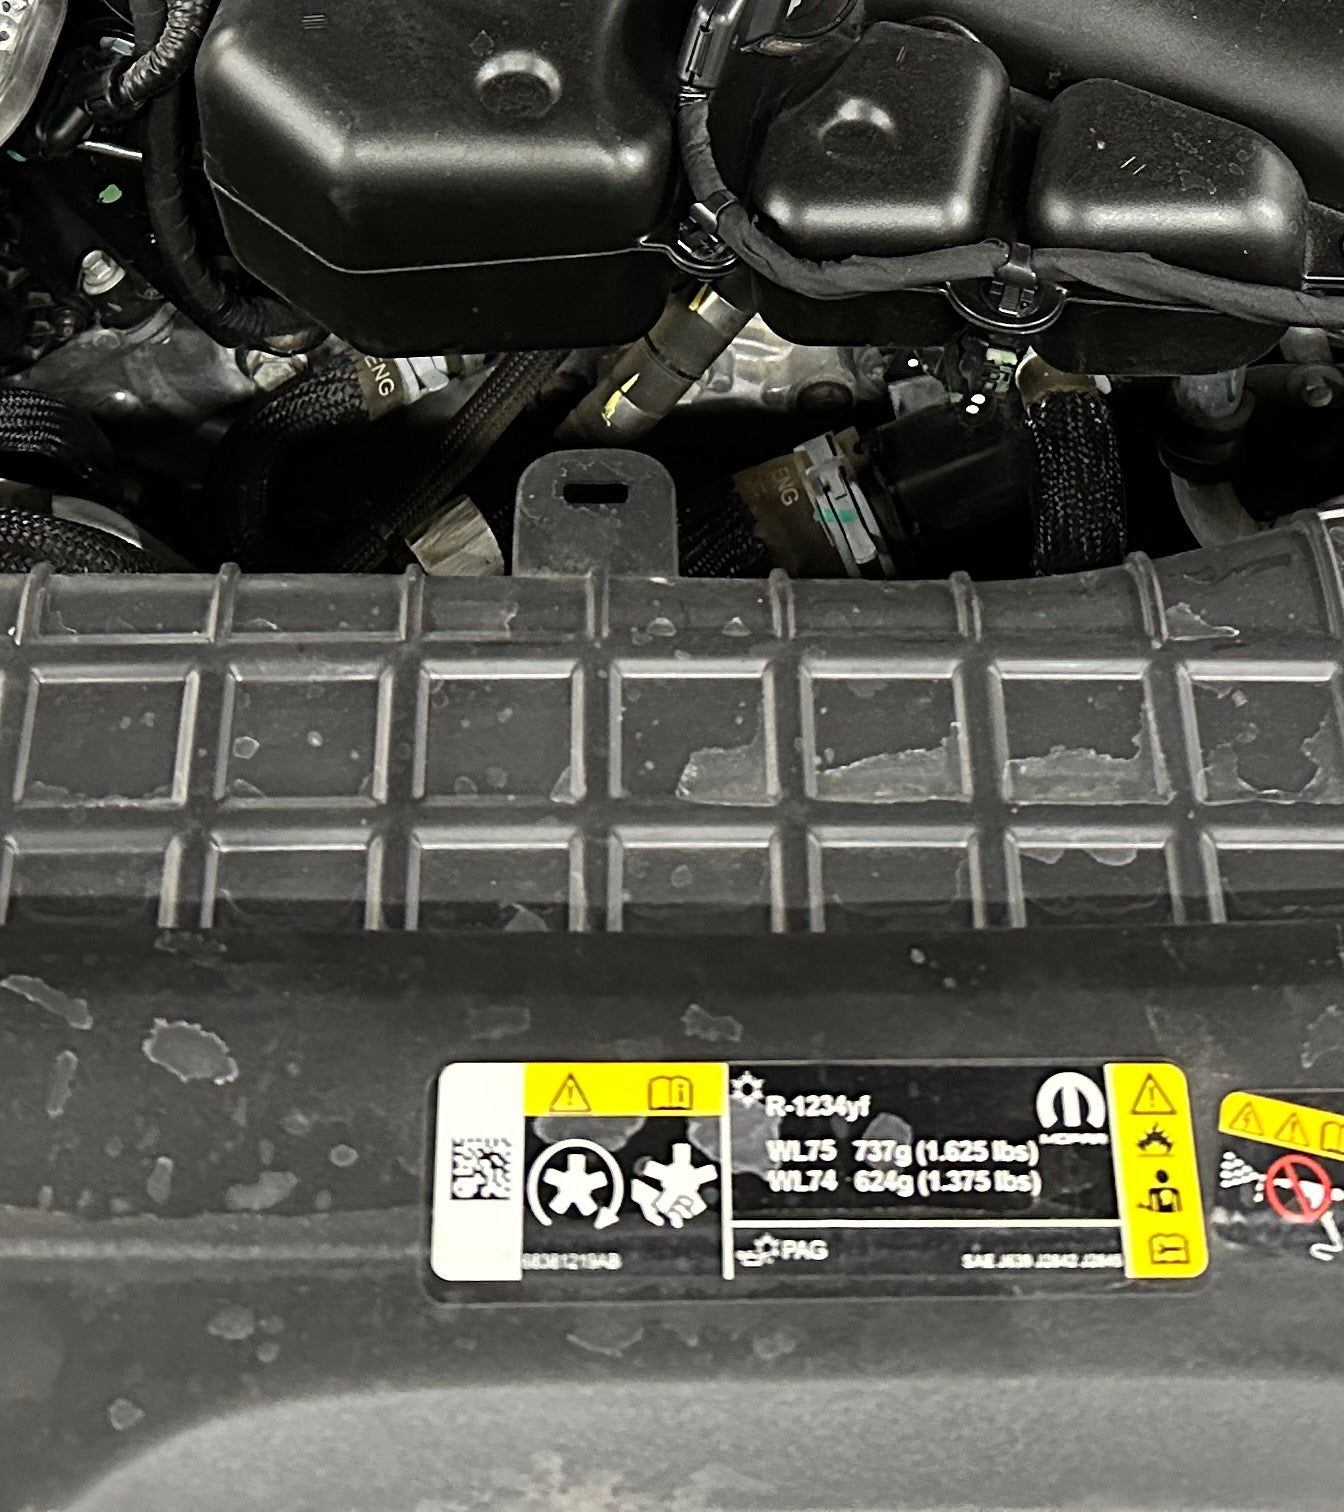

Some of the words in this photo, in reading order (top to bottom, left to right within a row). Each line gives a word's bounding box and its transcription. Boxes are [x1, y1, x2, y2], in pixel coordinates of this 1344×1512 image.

[765, 1095, 871, 1122] R-1234yf
[765, 1139, 838, 1163] WL75
[851, 1139, 912, 1167] 737g
[915, 1139, 990, 1166] (1.625
[991, 1139, 1040, 1166] lbs)
[767, 1170, 839, 1193] WL74
[853, 1170, 915, 1196] 624g
[916, 1169, 992, 1196] (1.375
[993, 1170, 1042, 1196] lbs)
[778, 1239, 829, 1262] PAG
[961, 1253, 996, 1269] SAE
